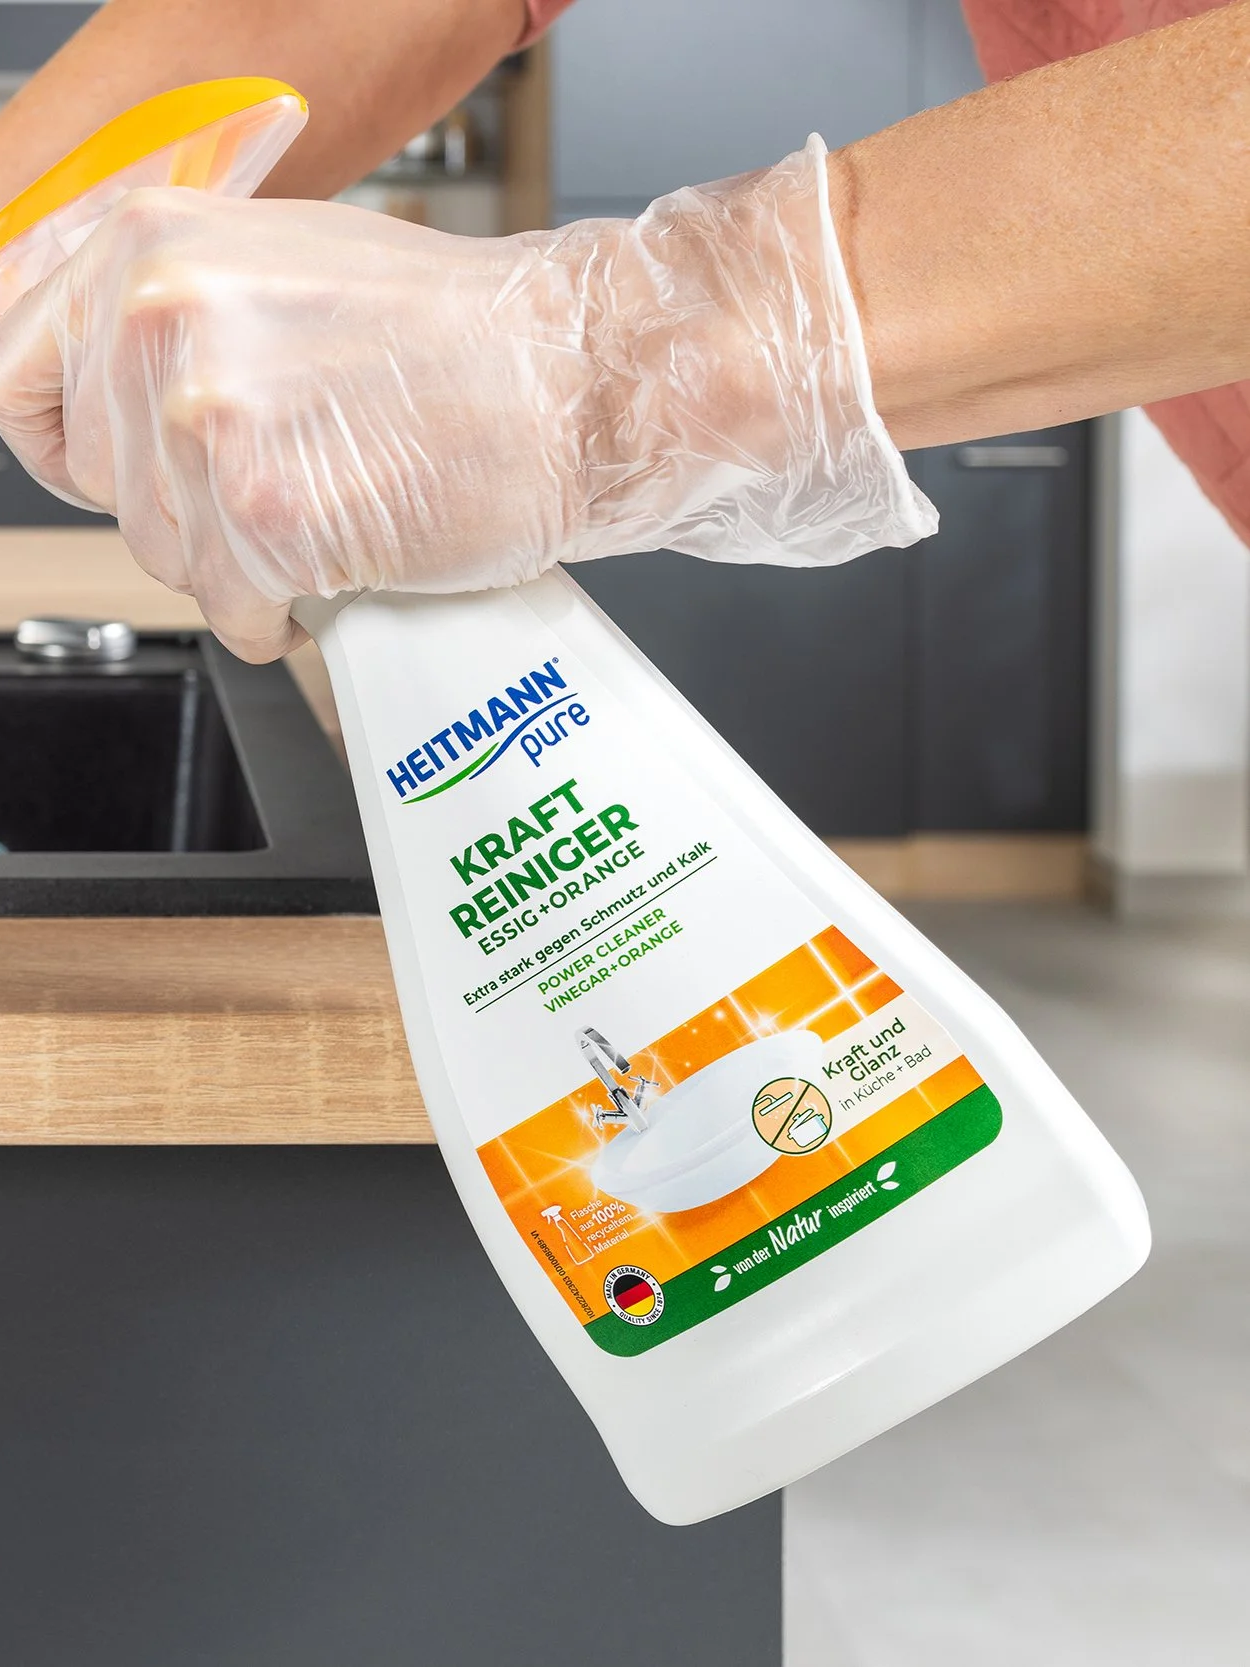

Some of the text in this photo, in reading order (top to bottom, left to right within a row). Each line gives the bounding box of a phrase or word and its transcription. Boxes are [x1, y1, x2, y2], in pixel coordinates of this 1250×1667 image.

[520, 703, 590, 768] pure
[449, 778, 584, 886] KRAFT
[448, 804, 640, 939] REINIGER
[477, 840, 645, 956] ESSIG+ORANGE
[463, 840, 712, 1006] Extra stark gegen Schmutz und Kalk
[537, 908, 667, 996] POWER CLEANER
[543, 920, 684, 1014] VINEGAR+ORANGE
[822, 1017, 906, 1079] Kraft und
[838, 1097, 855, 1111] in
[853, 1071, 896, 1102] Küche
[904, 1044, 932, 1068] Bad
[850, 1044, 901, 1081] Glanz
[570, 1199, 602, 1220] Flasche
[578, 1201, 626, 1232] aus 100%
[586, 1213, 634, 1243] recyceltem
[593, 1228, 630, 1254] Material
[733, 1180, 878, 1275] von der Natur inspiriert
[609, 1272, 618, 1280] IN
[616, 1267, 651, 1280] GERMANY
[619, 1311, 646, 1324] QUALITY
[646, 1308, 661, 1322] SINCE
